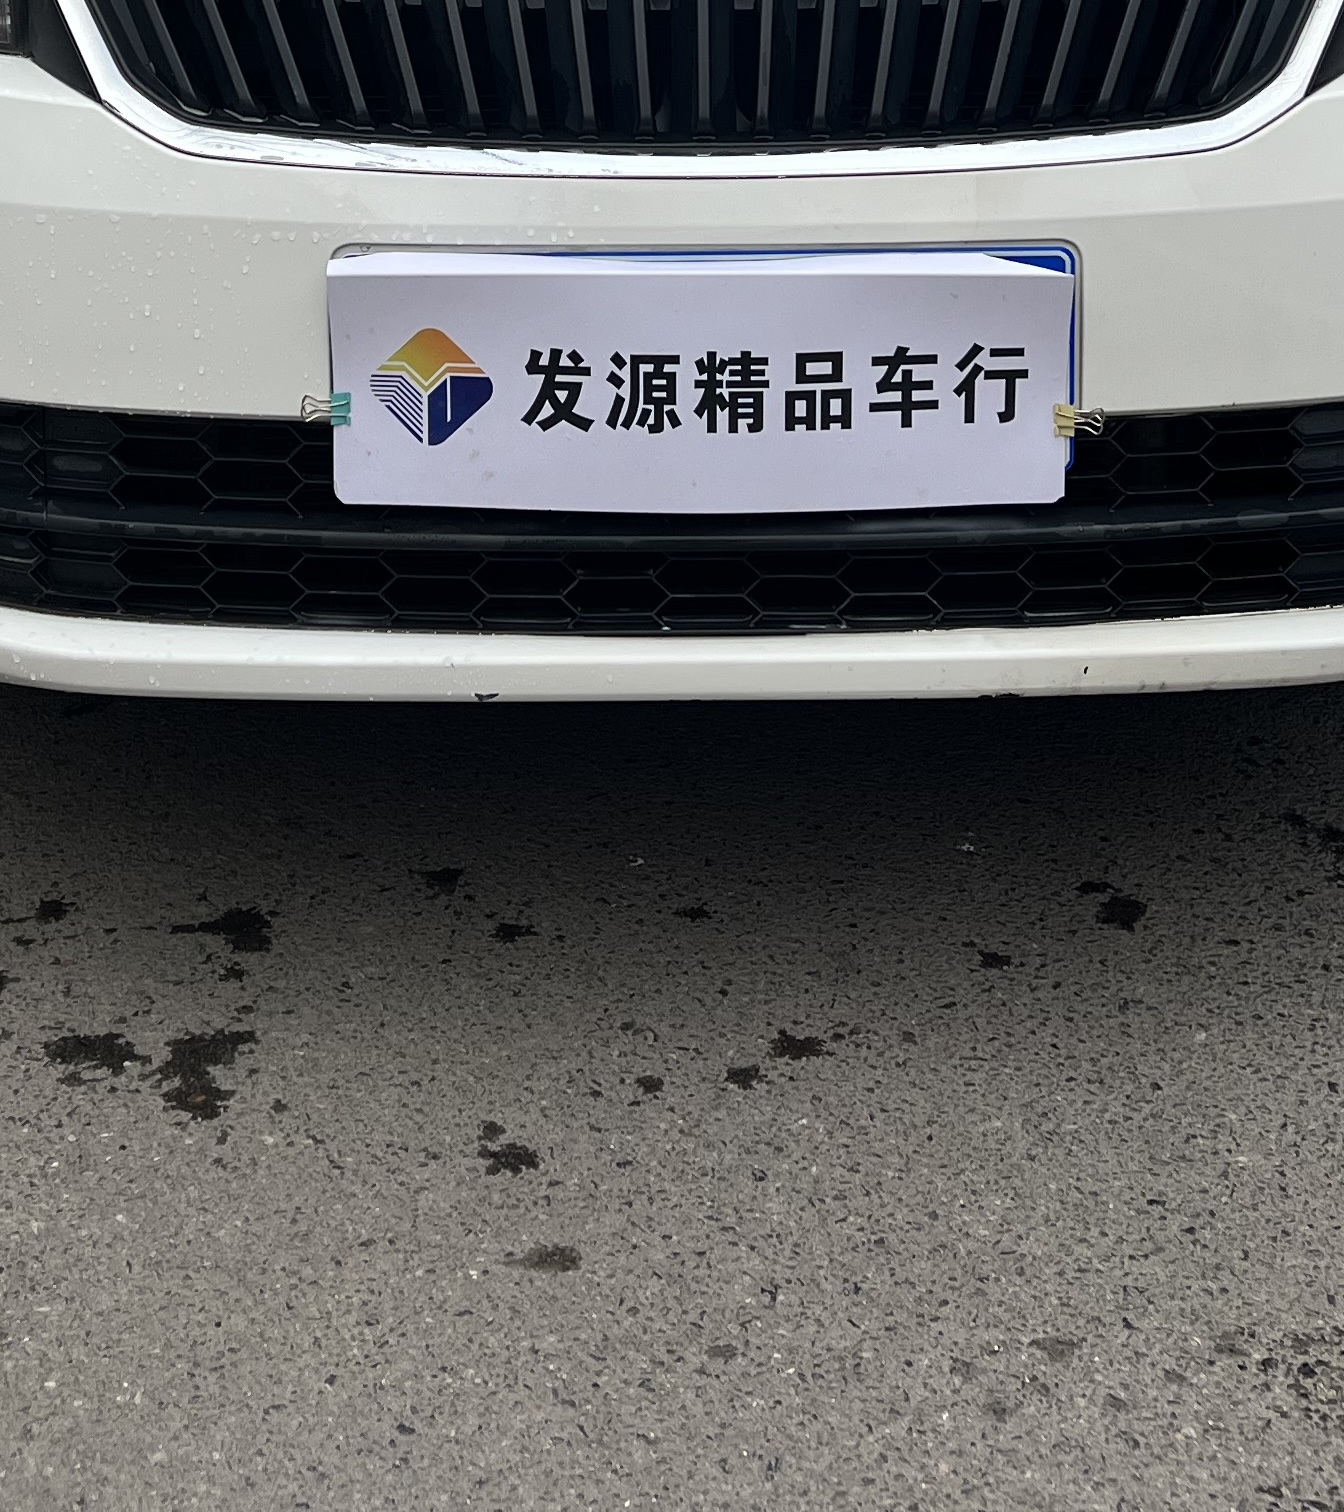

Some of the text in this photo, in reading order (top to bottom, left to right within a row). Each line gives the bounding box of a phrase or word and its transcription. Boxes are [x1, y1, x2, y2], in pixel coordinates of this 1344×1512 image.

[521, 341, 1032, 435] 发源精品车行
